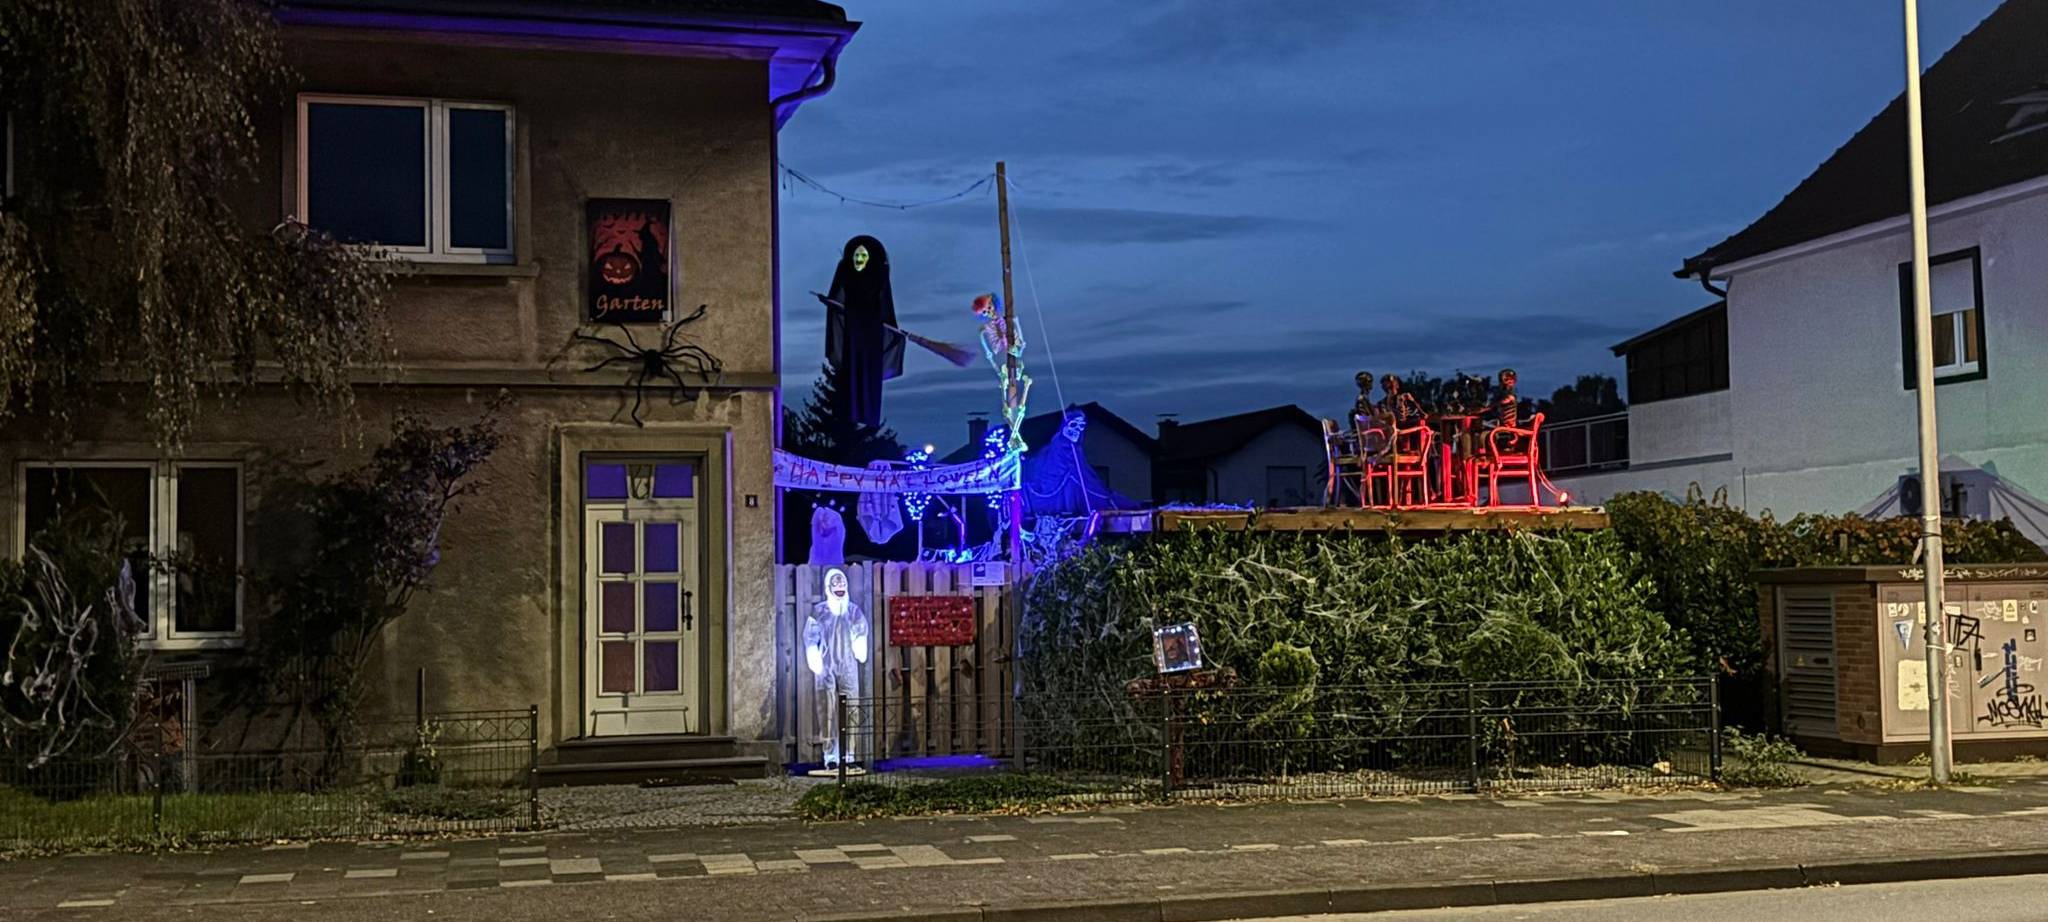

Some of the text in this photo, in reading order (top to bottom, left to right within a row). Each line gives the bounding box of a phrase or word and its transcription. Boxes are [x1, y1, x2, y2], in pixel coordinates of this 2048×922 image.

[596, 294, 664, 319] Garten
[790, 462, 1000, 488] HAPPY HALLOWEEN
